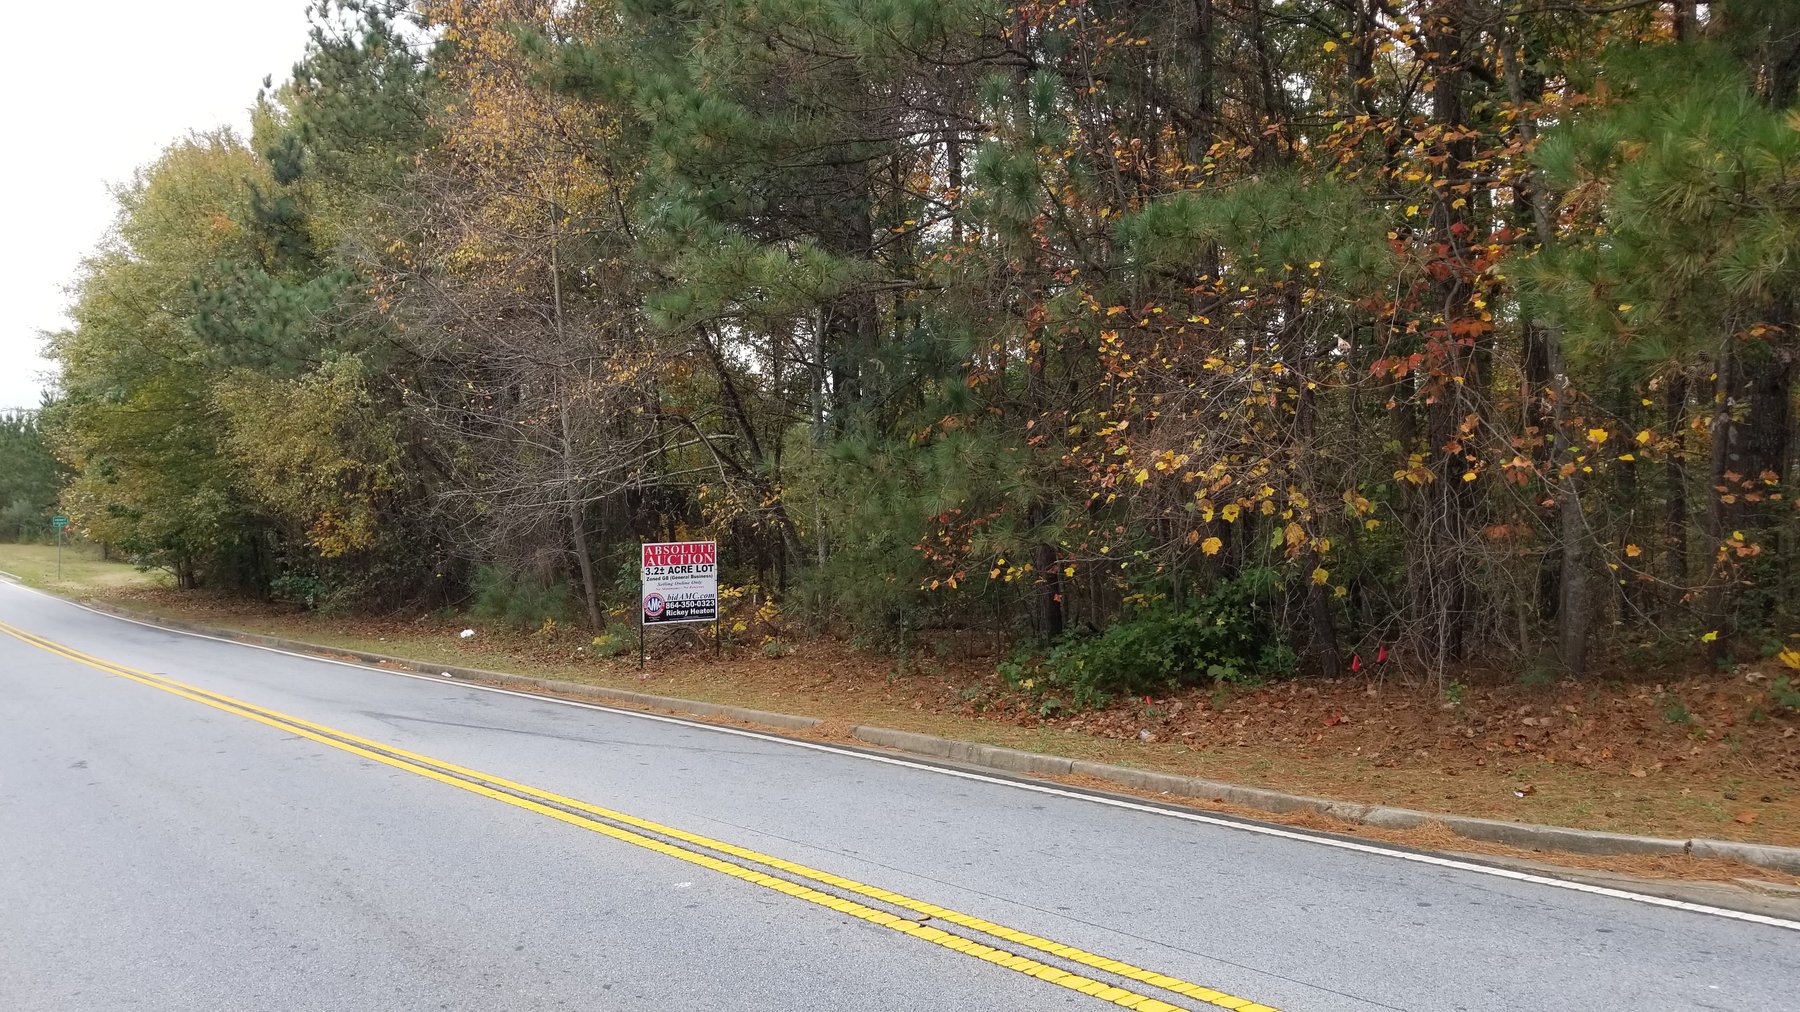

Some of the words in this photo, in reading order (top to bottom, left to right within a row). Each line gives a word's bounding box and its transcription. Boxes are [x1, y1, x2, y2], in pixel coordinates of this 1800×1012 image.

[645, 544, 714, 555] ABSOLUTE
[646, 553, 713, 566] AUCTION
[645, 567, 664, 575] 3.2±
[668, 566, 693, 574] ACRE
[667, 592, 714, 600] bidAMC.com
[647, 597, 662, 611] AMC
[666, 600, 714, 609] 864-350-0323
